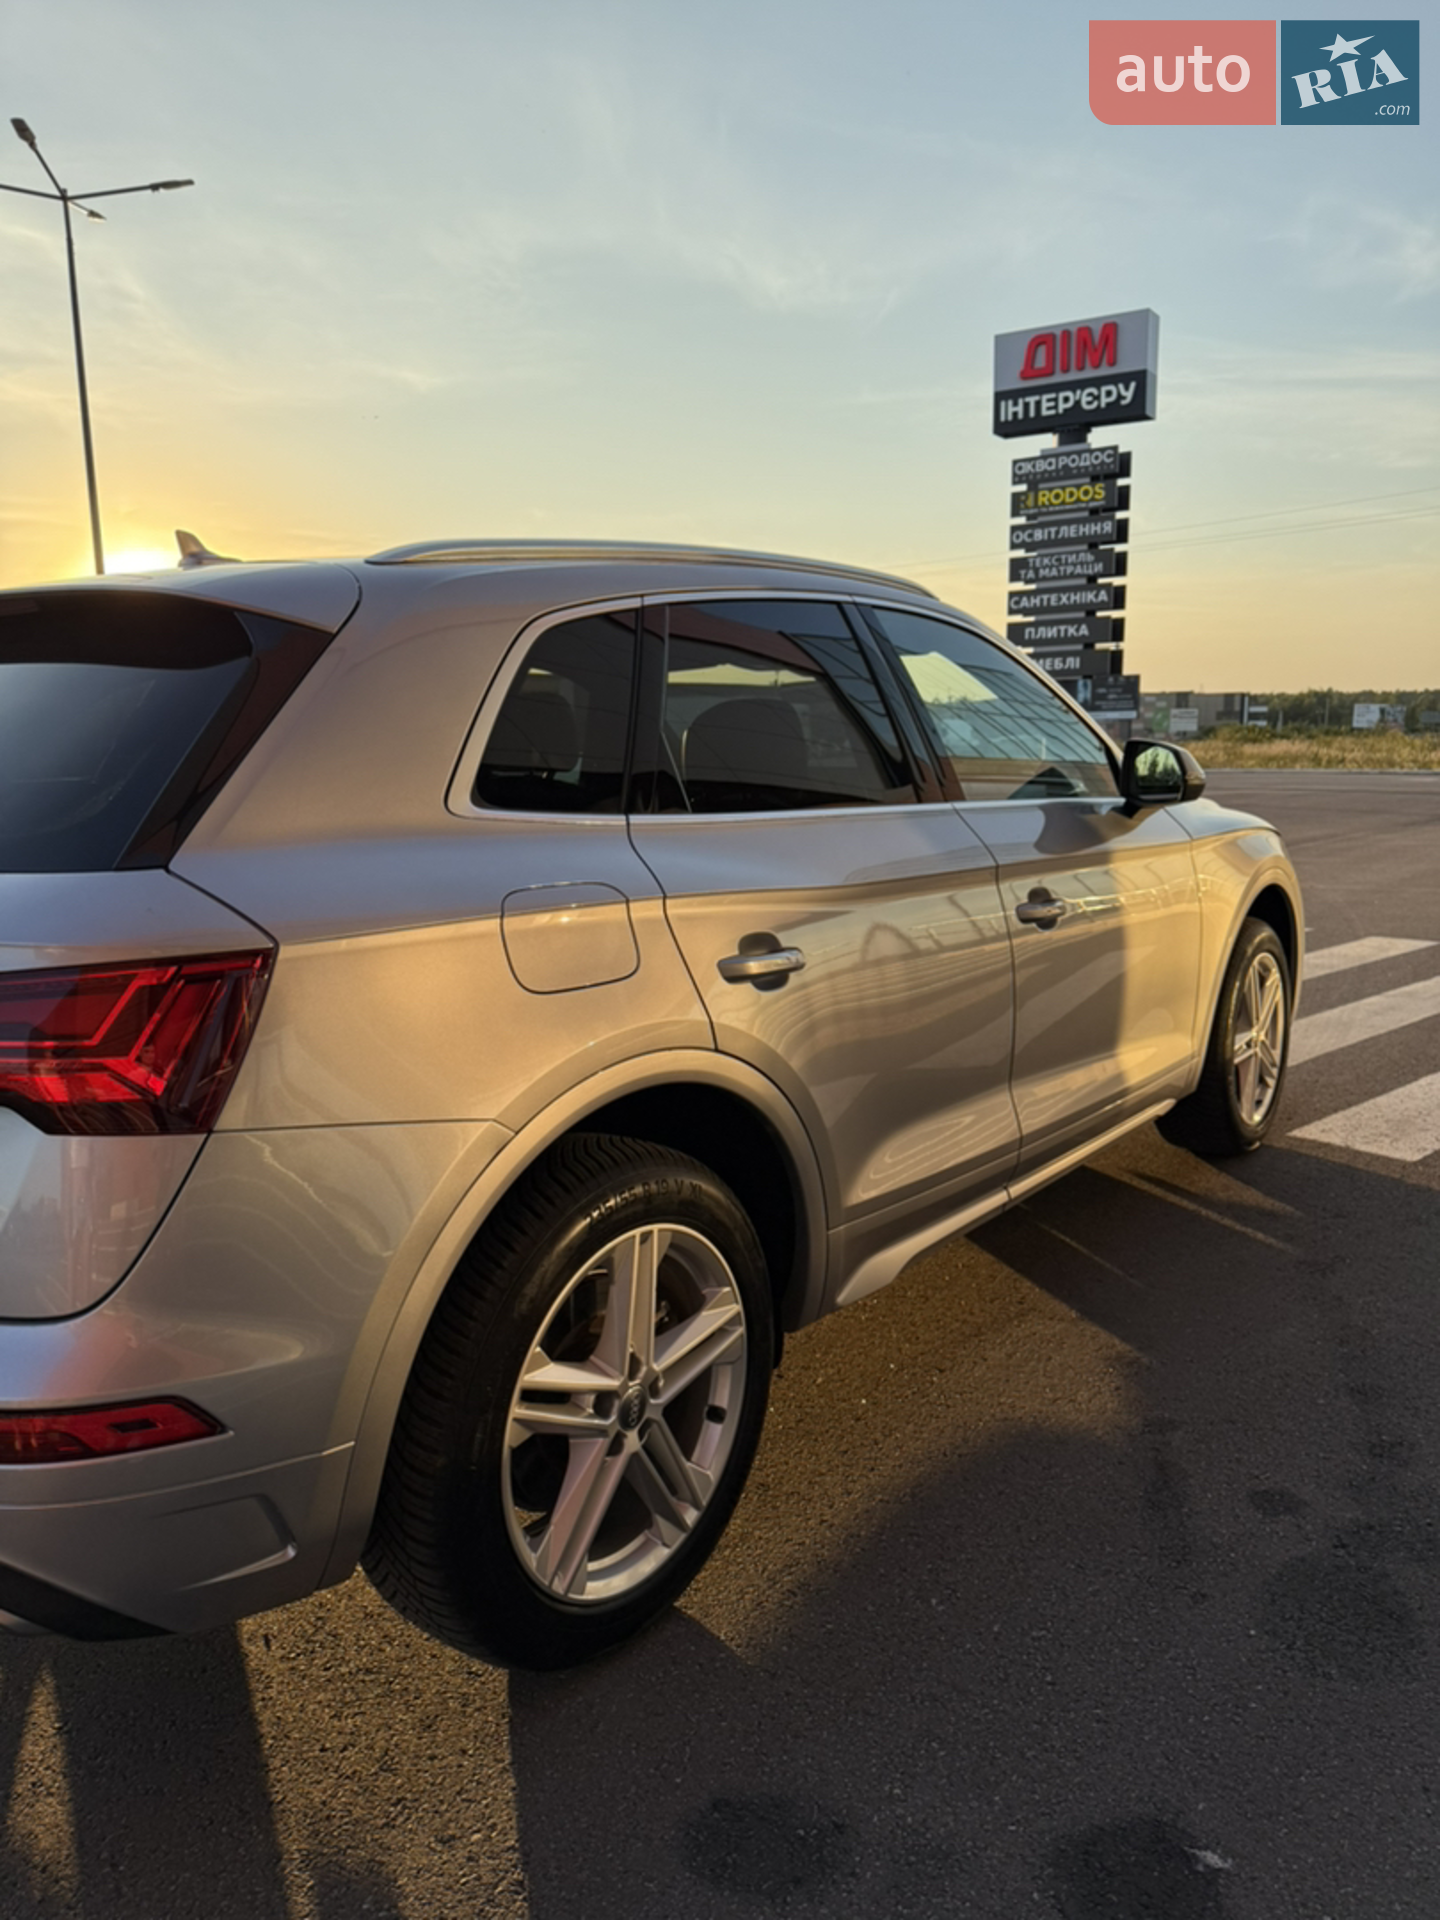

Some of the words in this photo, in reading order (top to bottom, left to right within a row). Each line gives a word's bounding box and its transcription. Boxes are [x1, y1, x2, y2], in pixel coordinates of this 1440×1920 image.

[1019, 320, 1117, 380] ДІМ
[1037, 483, 1106, 507] RODOS
[1012, 520, 1113, 544] ОСВІТЛЕННЯ
[1027, 552, 1096, 568] ТЕКСТИЛЬ
[1019, 568, 1036, 580] ТА
[1038, 561, 1104, 578] МАТРАЦИ
[1009, 589, 1109, 609] САНТЕХНІКА
[1023, 623, 1090, 640] ПЛИТКА
